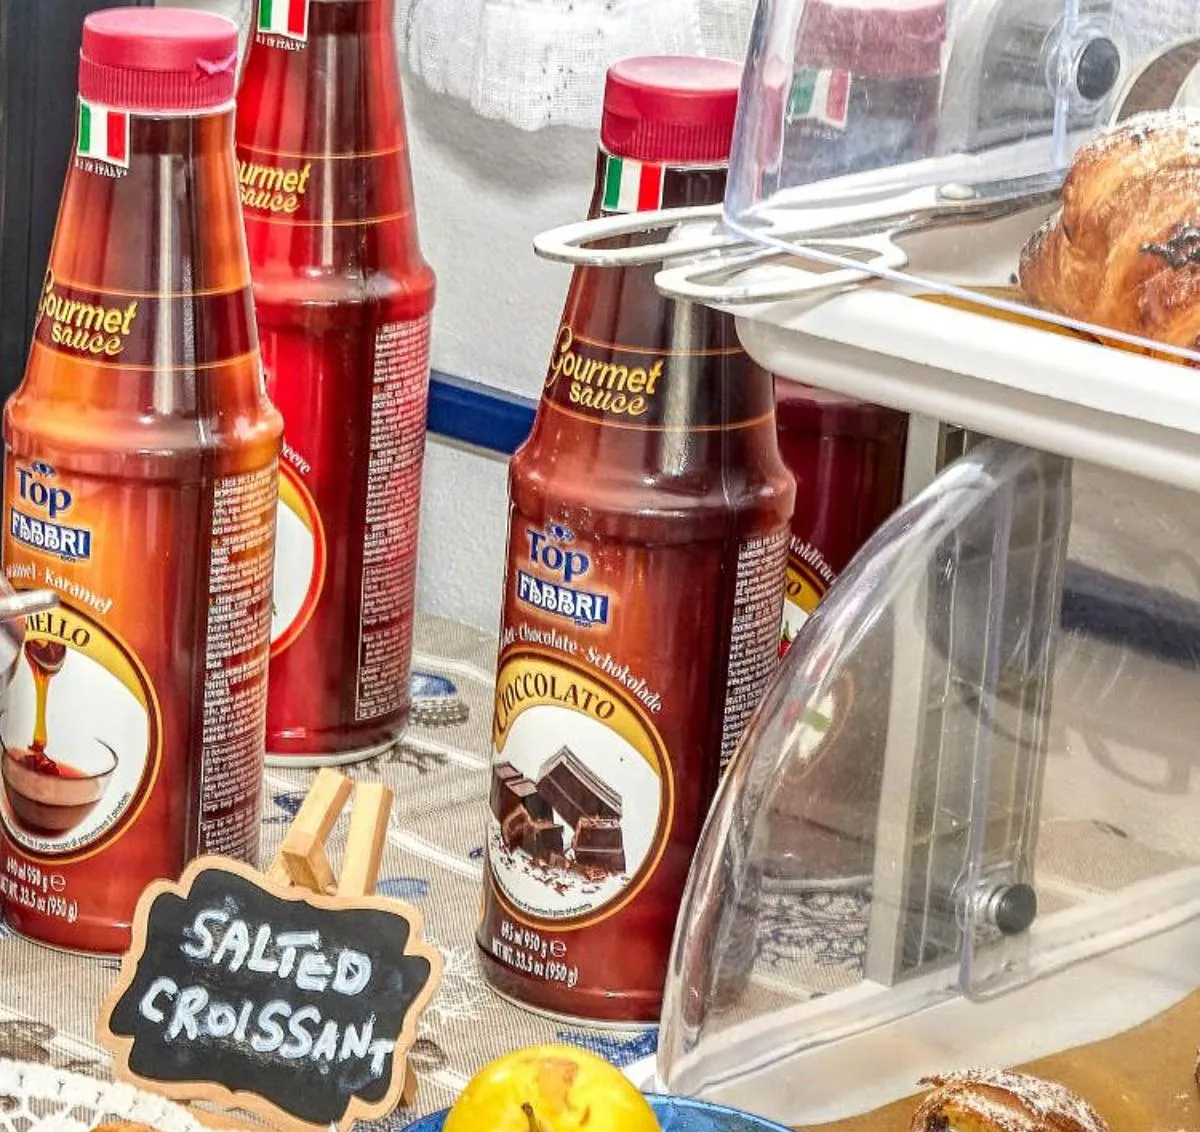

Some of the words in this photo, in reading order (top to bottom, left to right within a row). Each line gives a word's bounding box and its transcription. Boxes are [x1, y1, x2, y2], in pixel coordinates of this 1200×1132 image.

[51, 322, 125, 356] sauce
[569, 381, 649, 416] sauce
[16, 466, 72, 518] Top
[12, 509, 87, 557] FABBRI
[527, 529, 590, 583] Top
[519, 572, 604, 622] FABBRI
[584, 646, 663, 714] Schokolade
[180, 909, 372, 996] SALTED
[515, 948, 533, 975] 33.5
[139, 976, 395, 1078] CROISSANT
